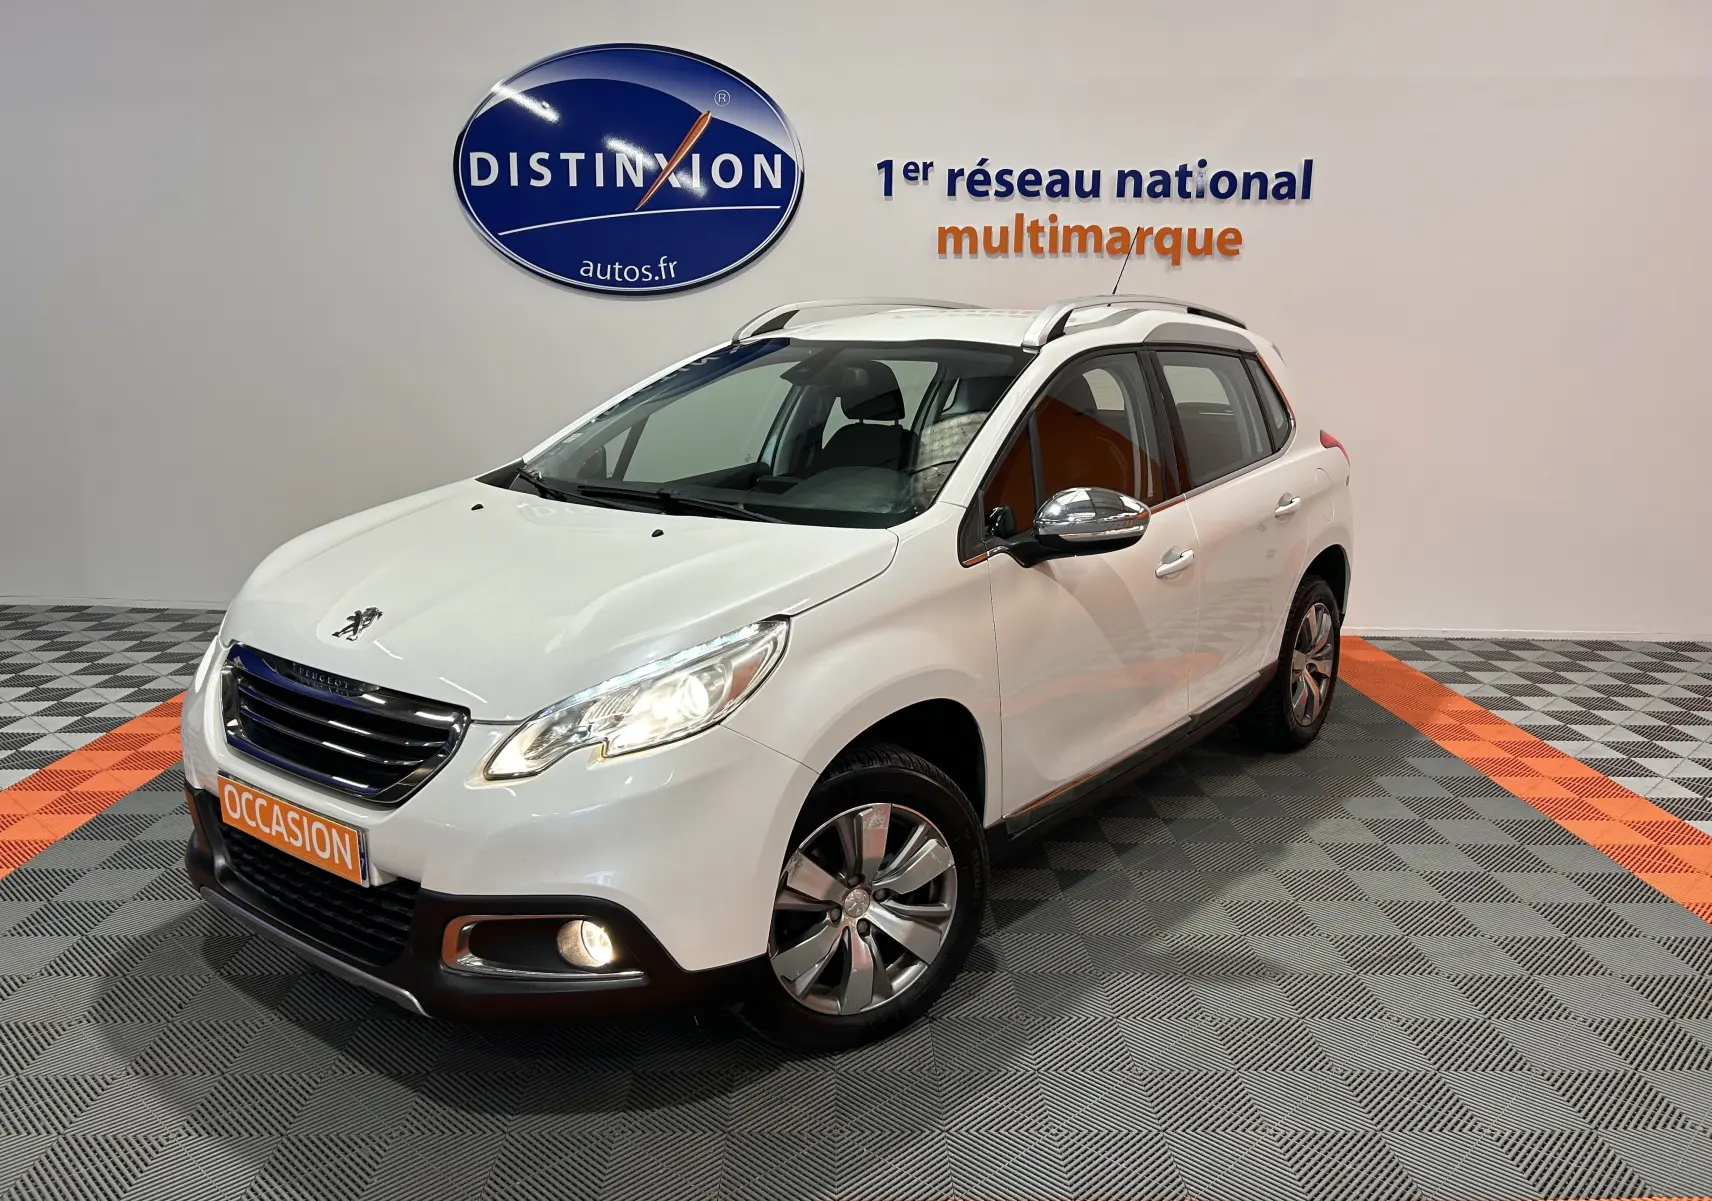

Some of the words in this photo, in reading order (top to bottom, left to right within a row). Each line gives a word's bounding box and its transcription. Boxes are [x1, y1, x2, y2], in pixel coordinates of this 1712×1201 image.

[469, 151, 782, 189] DISTINXION
[876, 158, 933, 196] 1er
[946, 157, 1100, 197] réseau
[1116, 158, 1313, 200] national
[936, 213, 1242, 266] multimarque
[579, 256, 678, 281] autos.fr
[299, 667, 348, 689] PEUGEOT
[223, 785, 353, 869] OCCASION
